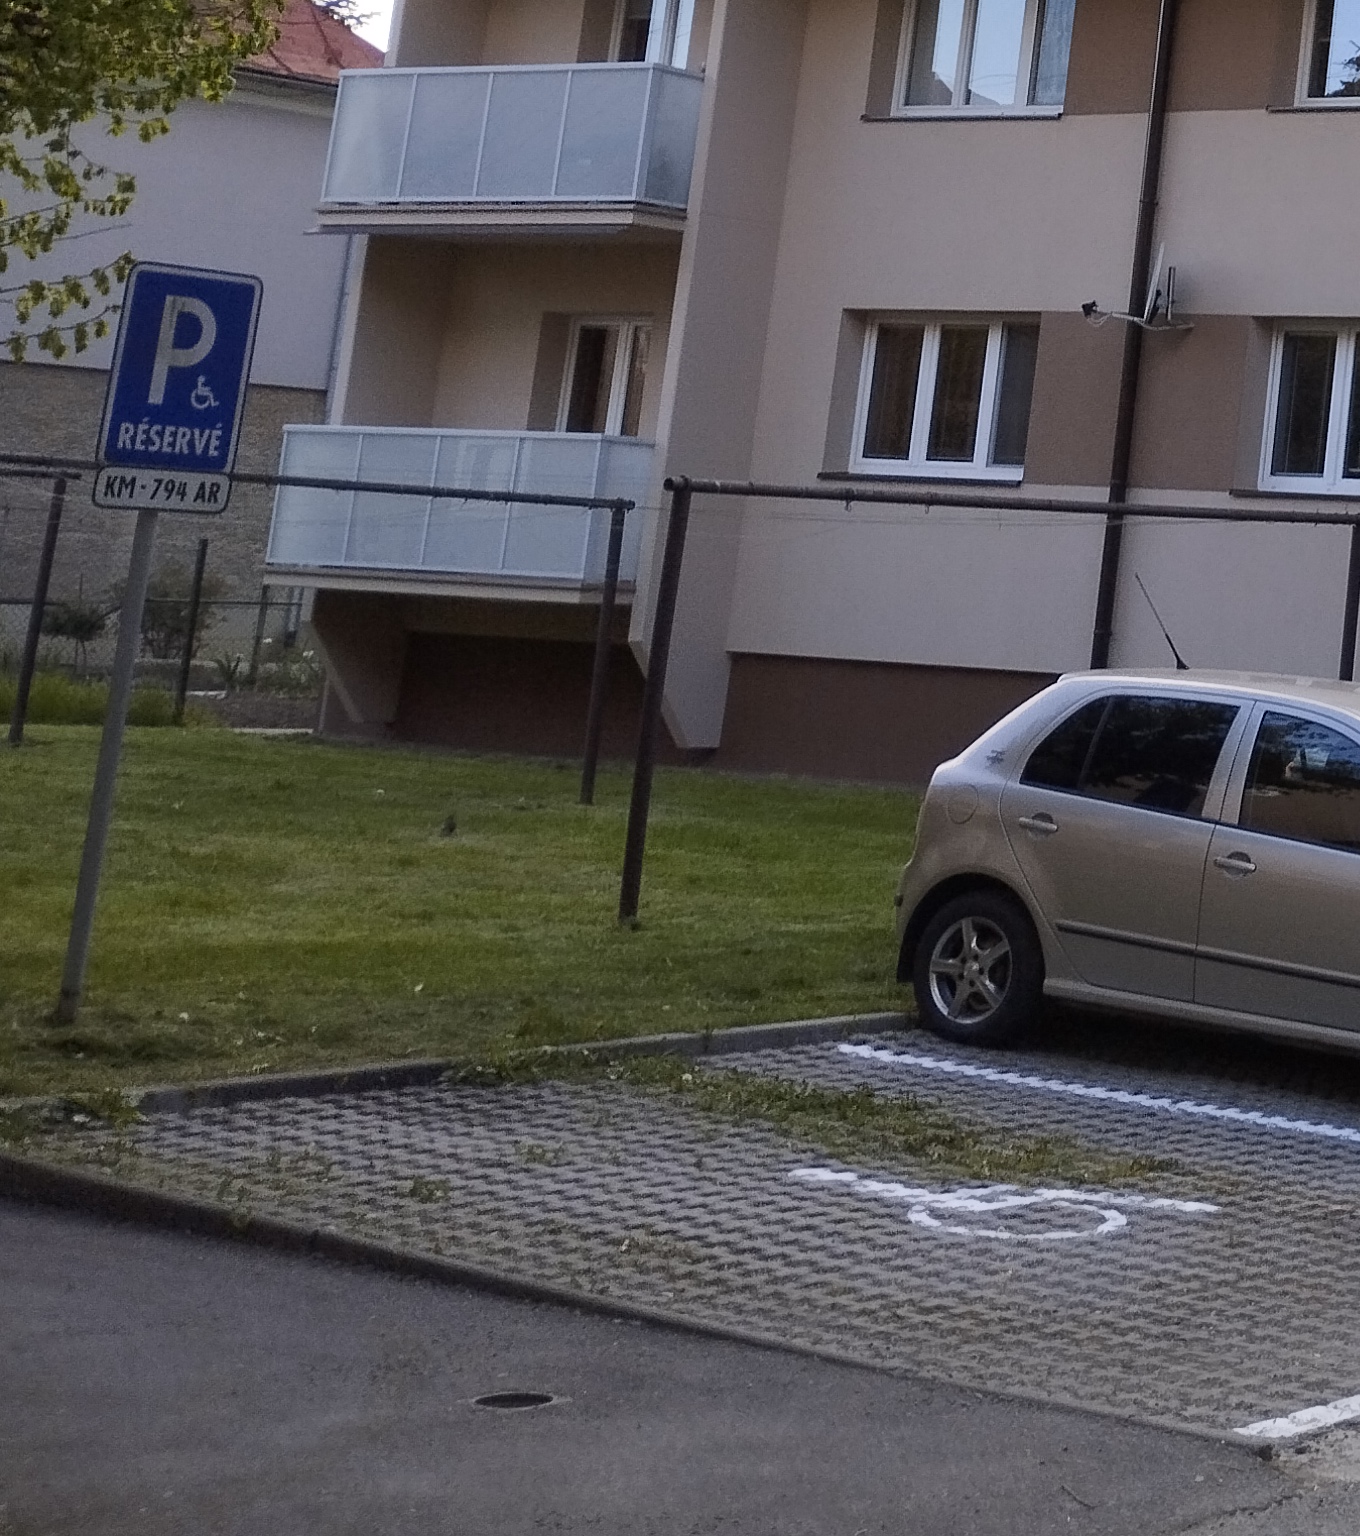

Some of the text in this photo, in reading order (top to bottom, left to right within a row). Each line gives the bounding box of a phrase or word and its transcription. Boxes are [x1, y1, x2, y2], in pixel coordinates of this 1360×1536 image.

[148, 294, 217, 404] P
[117, 417, 223, 457] RÉSERVÉ
[193, 480, 221, 504] AR
